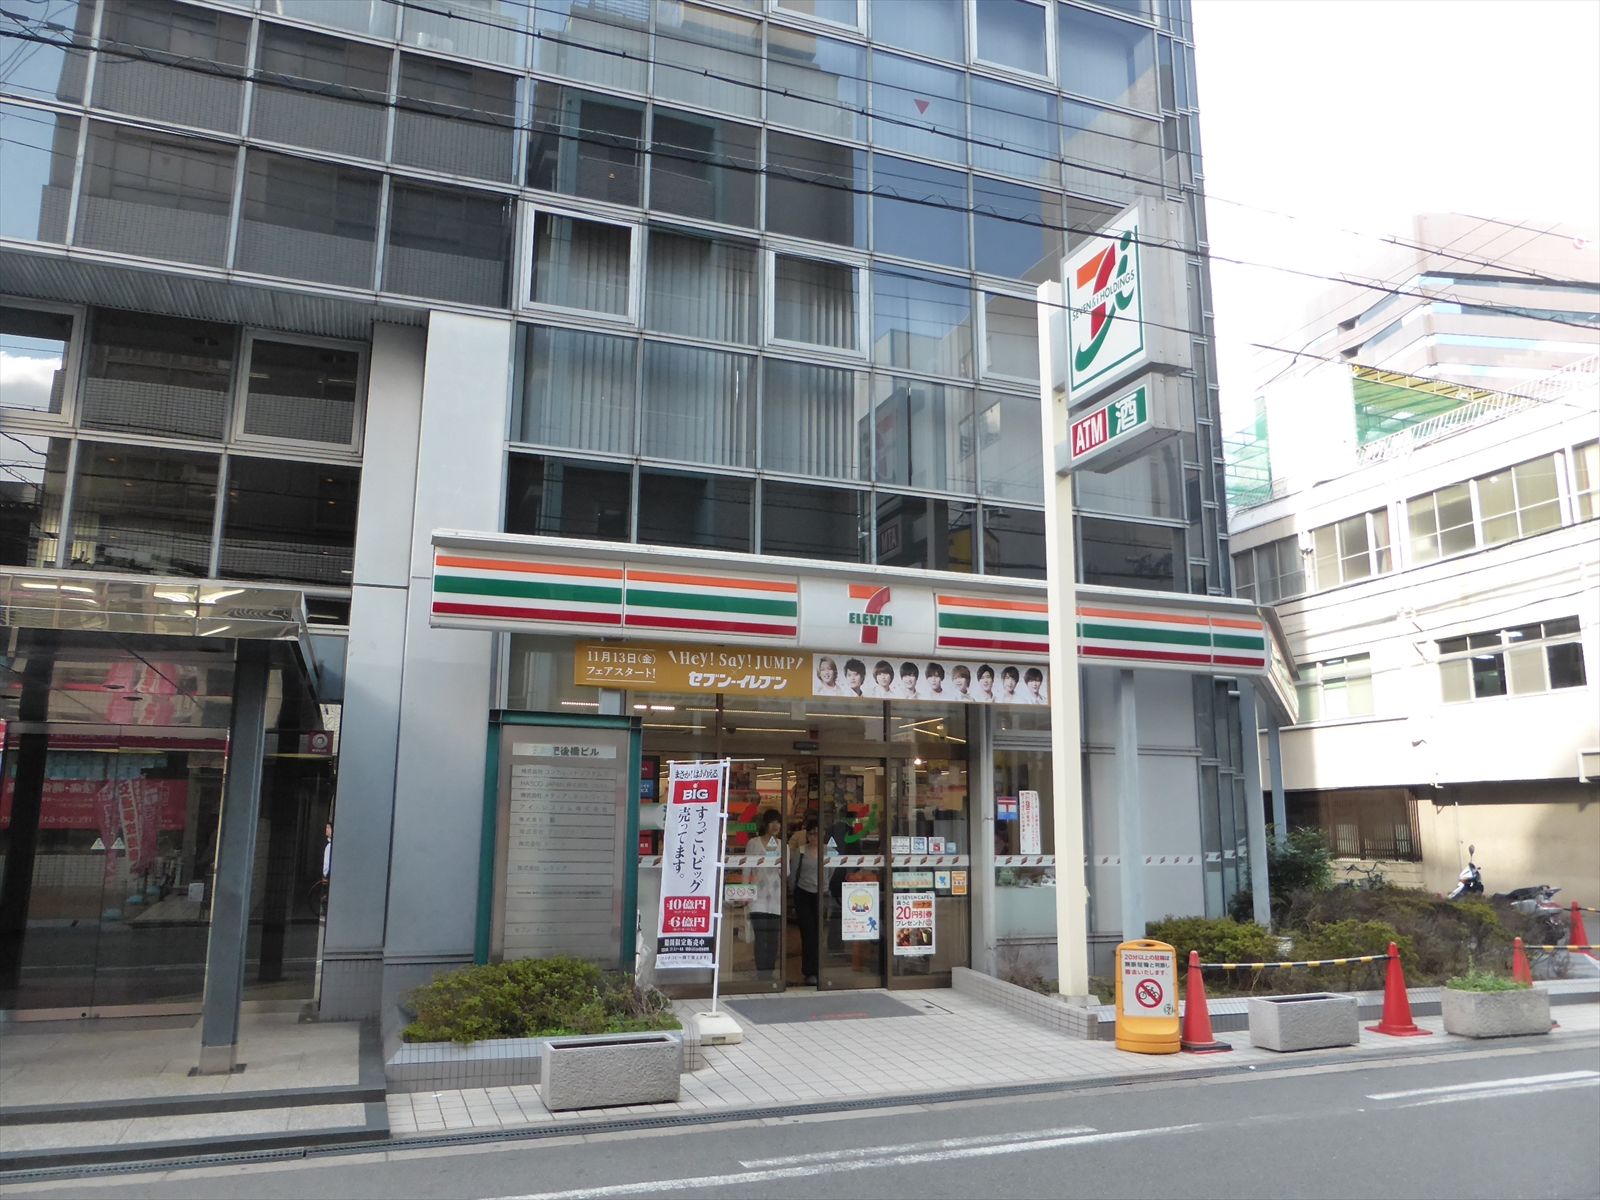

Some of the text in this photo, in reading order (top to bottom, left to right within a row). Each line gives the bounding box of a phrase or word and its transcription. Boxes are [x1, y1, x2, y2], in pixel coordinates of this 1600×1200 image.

[1100, 269, 1135, 302] HOLDINGS
[1115, 392, 1138, 435] 酒
[1076, 413, 1103, 454] ATM
[586, 666, 656, 679] フェアスタート!
[587, 650, 657, 665] 11月13日(金)
[679, 651, 795, 671] Hey! Say! JUMP
[672, 806, 691, 879] 売ってます。
[690, 806, 709, 894] すっごいビッグ
